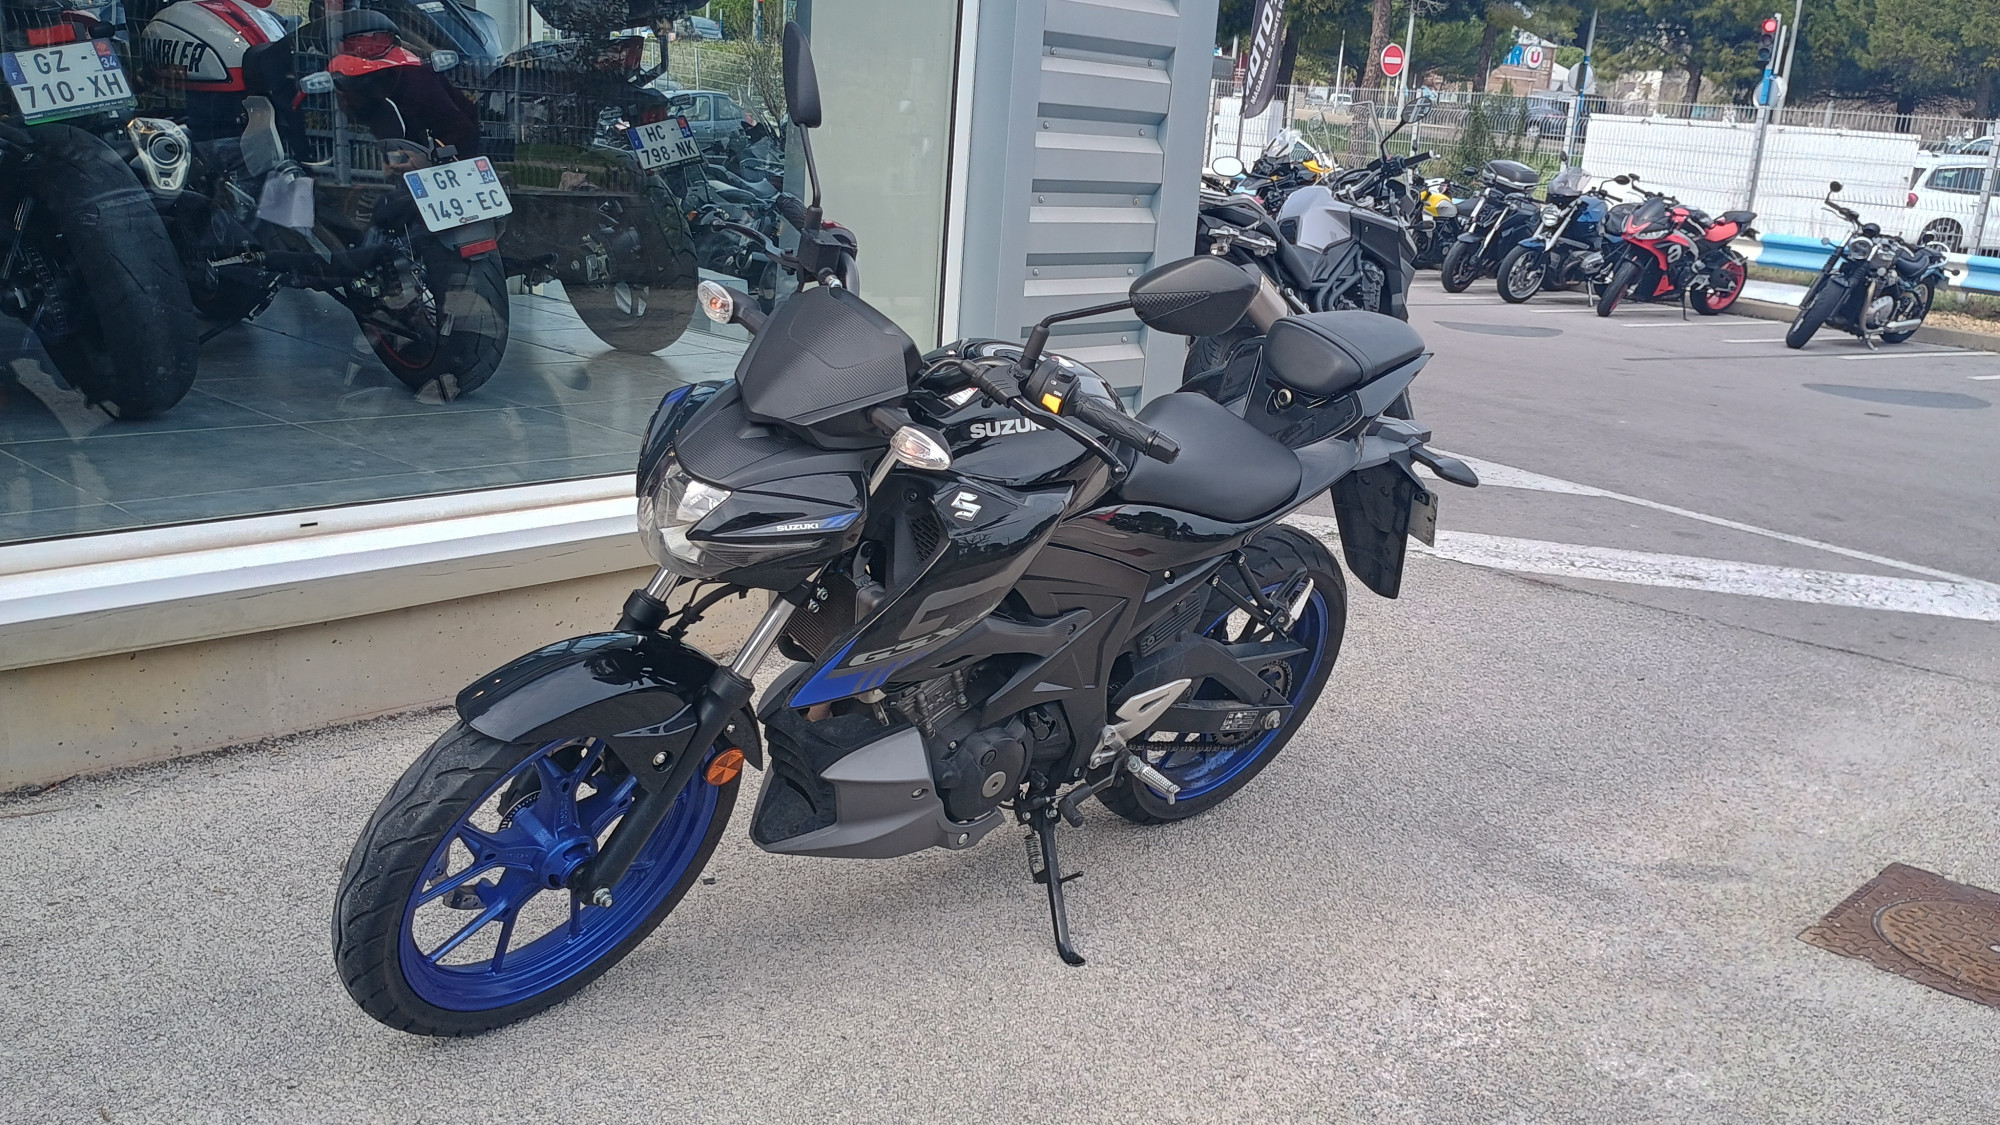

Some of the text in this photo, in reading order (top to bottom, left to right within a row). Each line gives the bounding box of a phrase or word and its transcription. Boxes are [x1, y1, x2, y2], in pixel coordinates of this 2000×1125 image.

[33, 50, 70, 75] GZ
[101, 56, 117, 68] 34
[1250, 60, 1269, 105] MAGASINS
[1266, 46, 1273, 59] DE
[1270, 11, 1282, 45] JOUETS
[11, 72, 18, 80] F
[645, 125, 666, 142] HC
[433, 169, 461, 190] GR
[481, 170, 494, 183] 34
[776, 523, 819, 532] SUZUKI
